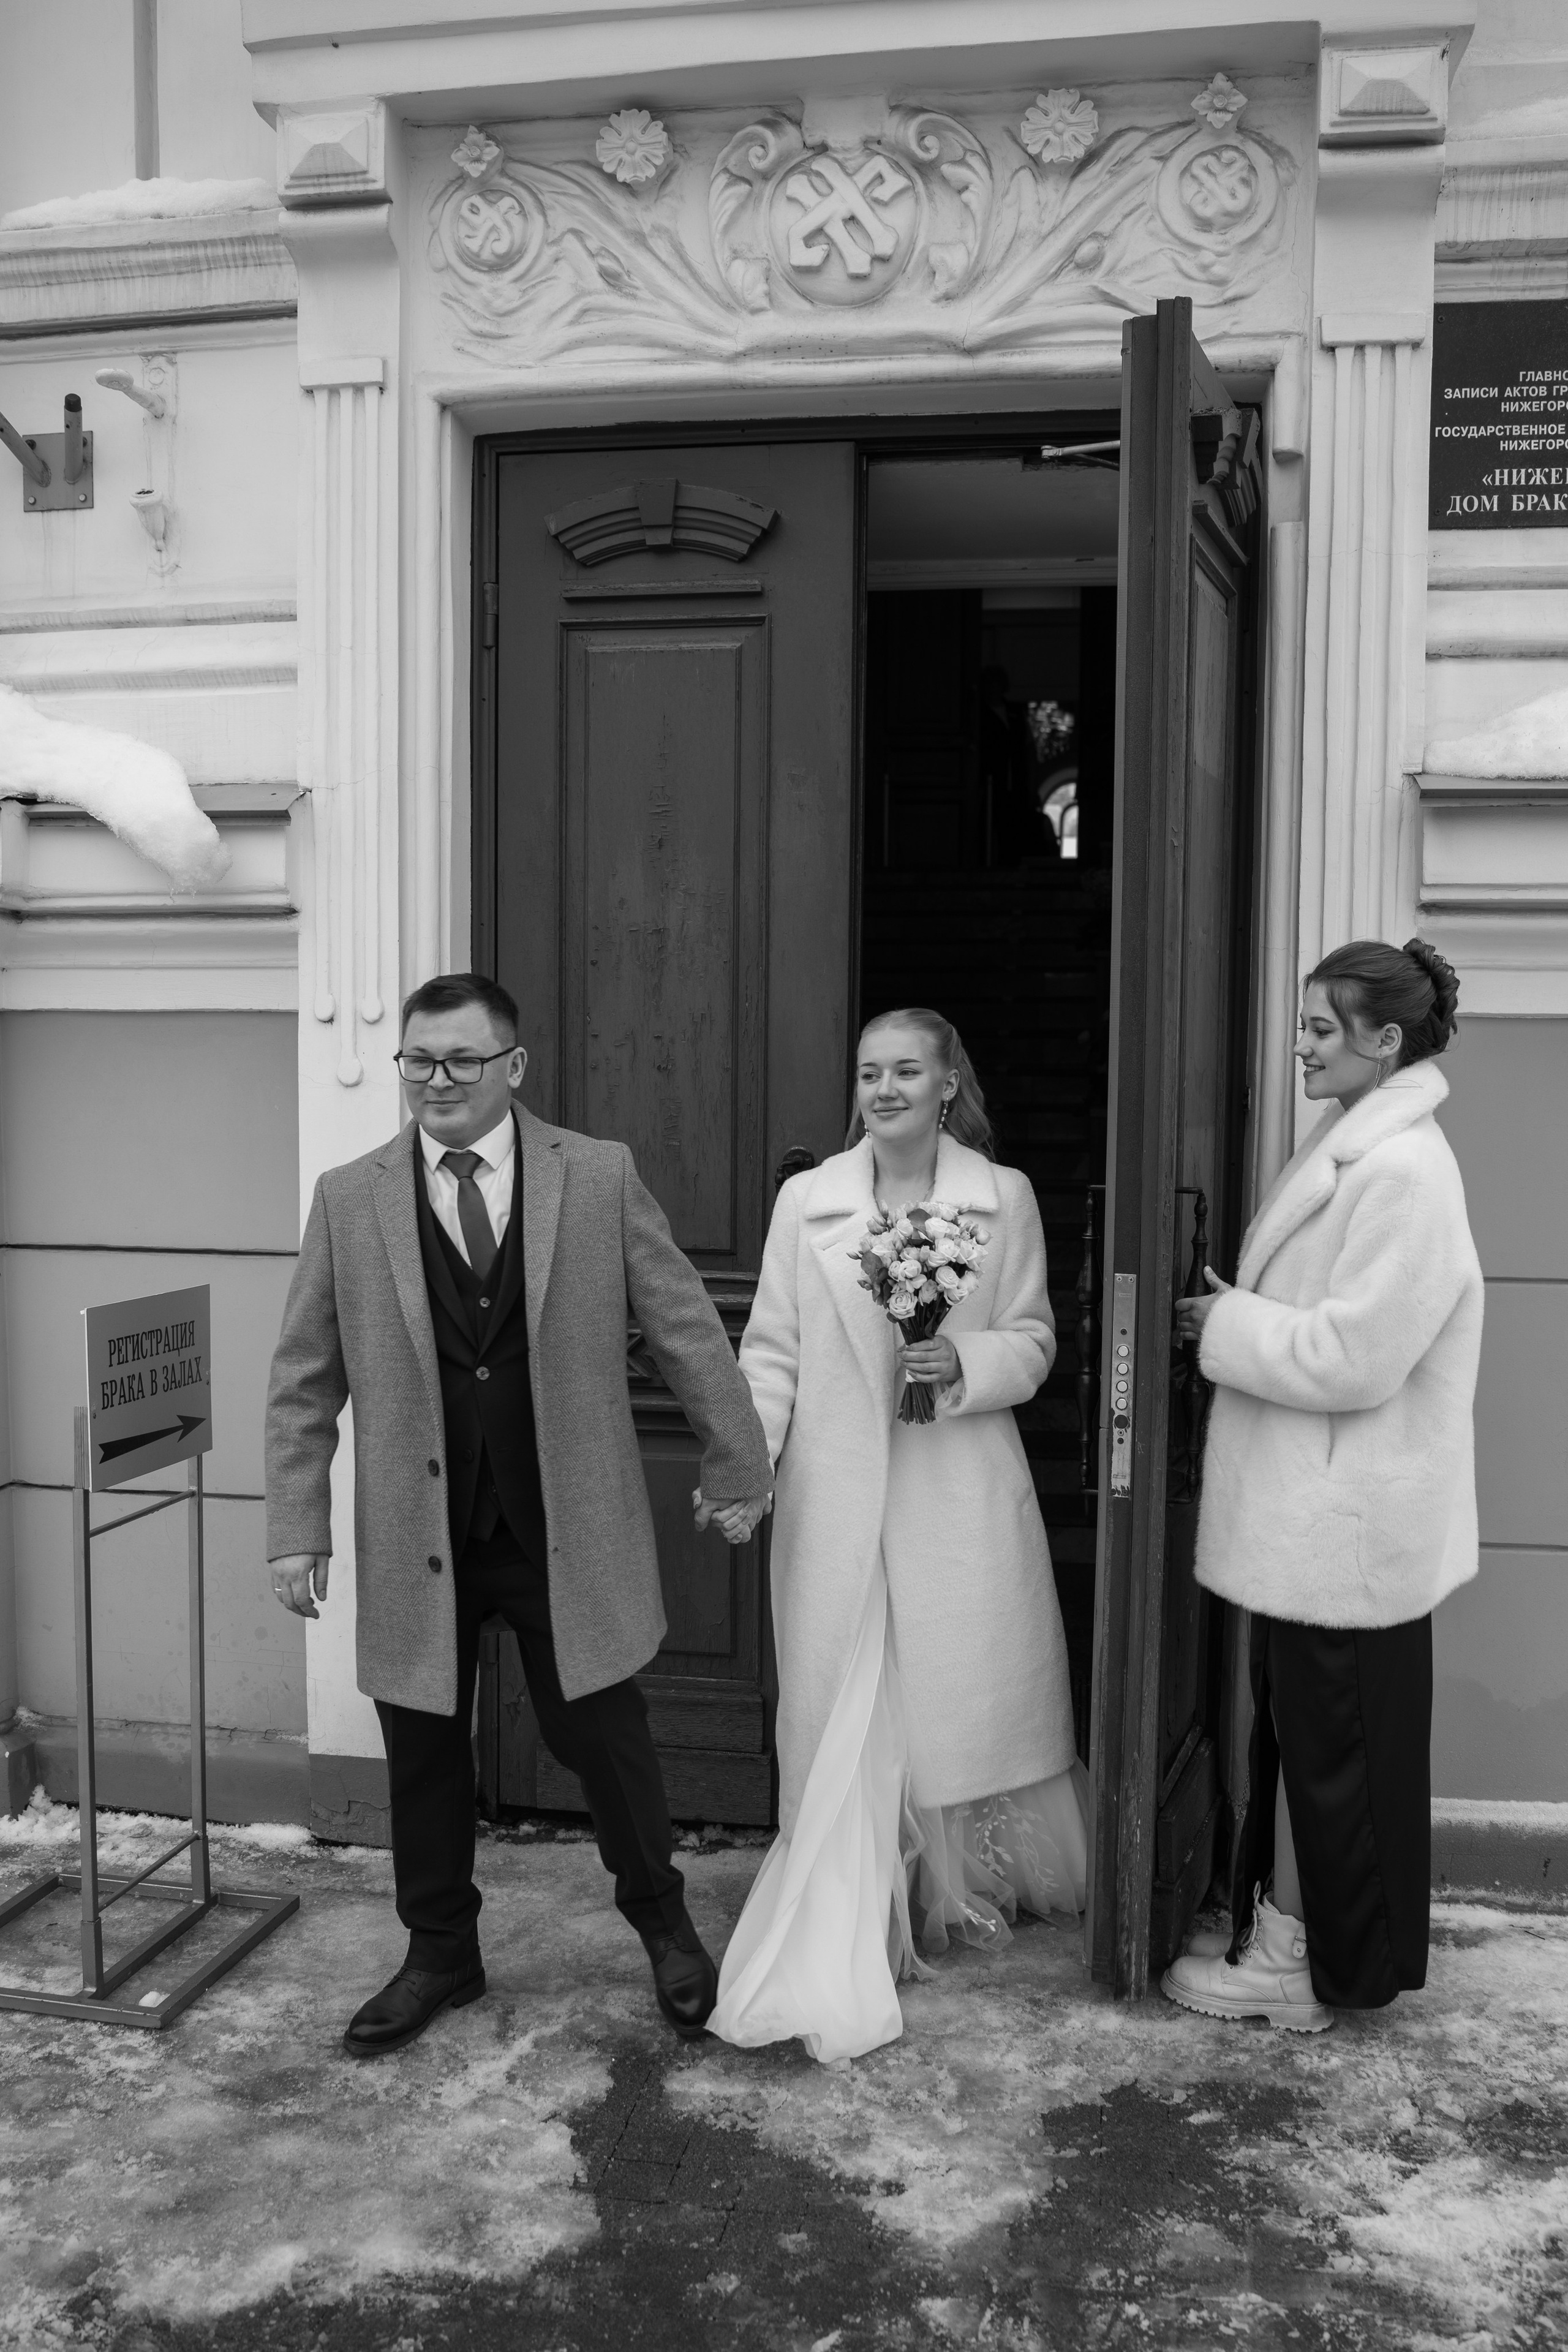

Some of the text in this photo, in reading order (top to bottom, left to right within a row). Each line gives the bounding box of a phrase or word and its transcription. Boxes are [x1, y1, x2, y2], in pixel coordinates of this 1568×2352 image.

[1444, 385, 1568, 399] ЗАПИСИ АКТОВ ГР
[1501, 400, 1568, 412] НИЖЕГОР
[1434, 424, 1566, 439] ГОСУДАРСТВЕННОЕ
[1482, 467, 1568, 486] «НИЖЕ
[1446, 493, 1568, 516] ДОМ БРАК
[108, 1320, 195, 1368] РЕГИСТРАЦИЯ
[100, 1355, 203, 1411] БРАКА В ЗАЛАХ
